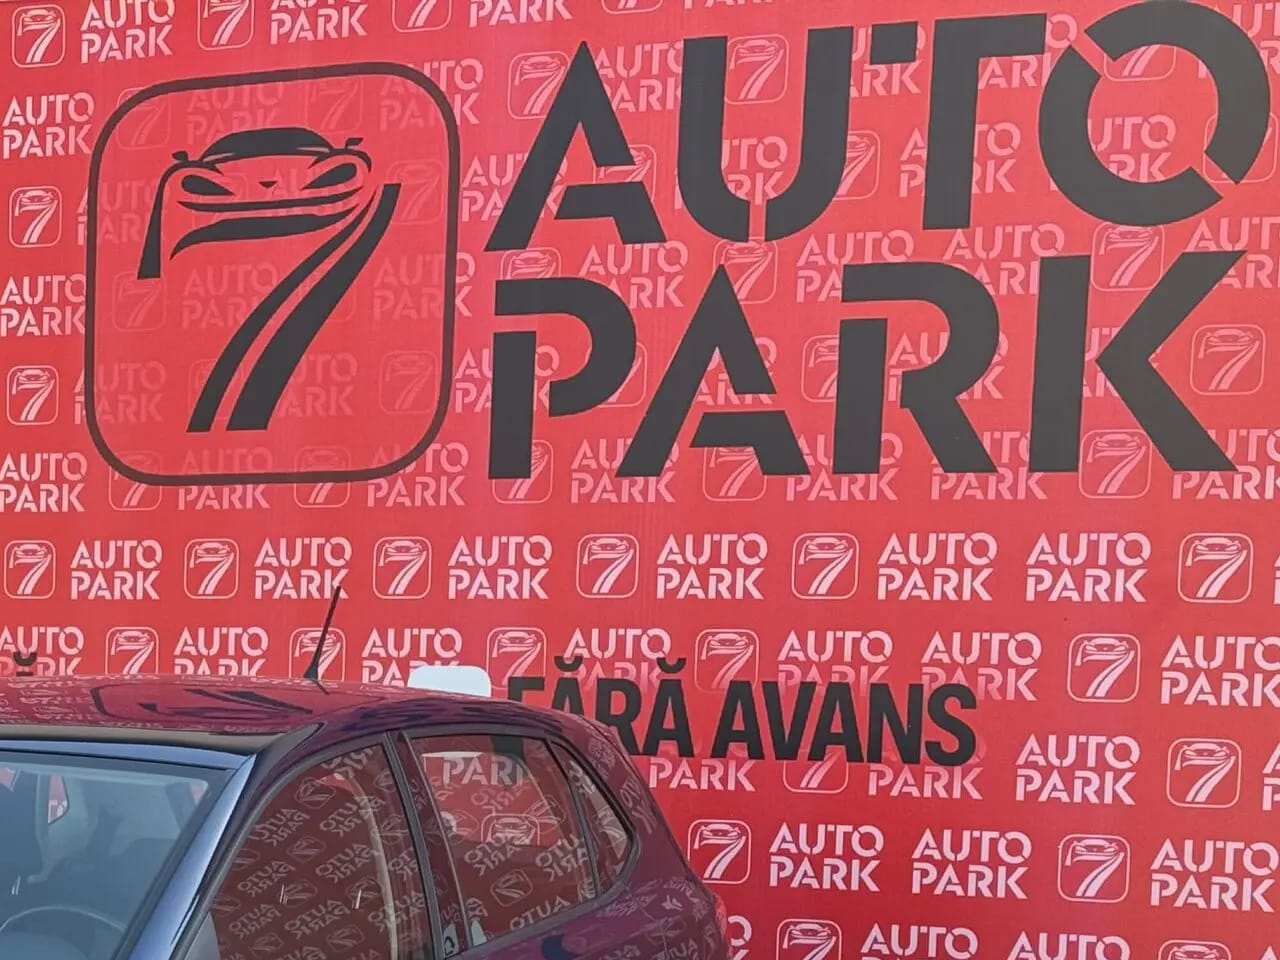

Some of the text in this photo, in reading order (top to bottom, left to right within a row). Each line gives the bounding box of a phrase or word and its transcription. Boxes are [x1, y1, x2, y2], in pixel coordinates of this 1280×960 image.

[81, 0, 174, 30] AUTO
[271, 4, 367, 44] PARK
[81, 25, 172, 63] PARK
[3, 93, 94, 126] AUTO
[484, 0, 1270, 251] AUTO
[3, 125, 92, 159] PARK
[798, 230, 913, 266] AUTO
[943, 224, 1064, 259] AUTO
[579, 241, 687, 277] AUTO
[0, 274, 86, 305] AUTO
[1, 305, 85, 337] PARK
[489, 250, 1247, 479] PARK
[368, 476, 464, 506] PARK
[572, 472, 674, 502] PARK
[786, 468, 898, 501] PARK
[931, 470, 1048, 501] PARK
[71, 540, 162, 569] AUTO
[255, 537, 352, 567] AUTO
[448, 535, 552, 566] AUTO
[657, 533, 767, 565] AUTO
[878, 533, 997, 565] AUTO
[1026, 533, 1151, 566] AUTO
[71, 571, 160, 600] PARK
[255, 569, 348, 599] PARK
[449, 568, 548, 599] PARK
[657, 567, 764, 599] PARK
[878, 568, 993, 600] PARK
[1026, 568, 1147, 602] PARK
[174, 627, 268, 656] AUTO
[362, 627, 463, 658] AUTO
[563, 628, 671, 660] AUTO
[778, 630, 892, 662] AUTO
[921, 632, 1041, 665] AUTO
[711, 680, 977, 766] AVANS
[1016, 734, 1140, 769] AUTO
[649, 757, 756, 791] PARK
[868, 764, 984, 799] PARK
[1016, 769, 1136, 805] PARK
[769, 822, 884, 857] AUTO
[912, 828, 1031, 864] AUTO
[770, 856, 880, 891] PARK
[1151, 838, 1279, 876] AUTO
[912, 862, 1028, 899] PARK
[1151, 873, 1274, 912] PARK
[860, 923, 978, 959] AUTO
